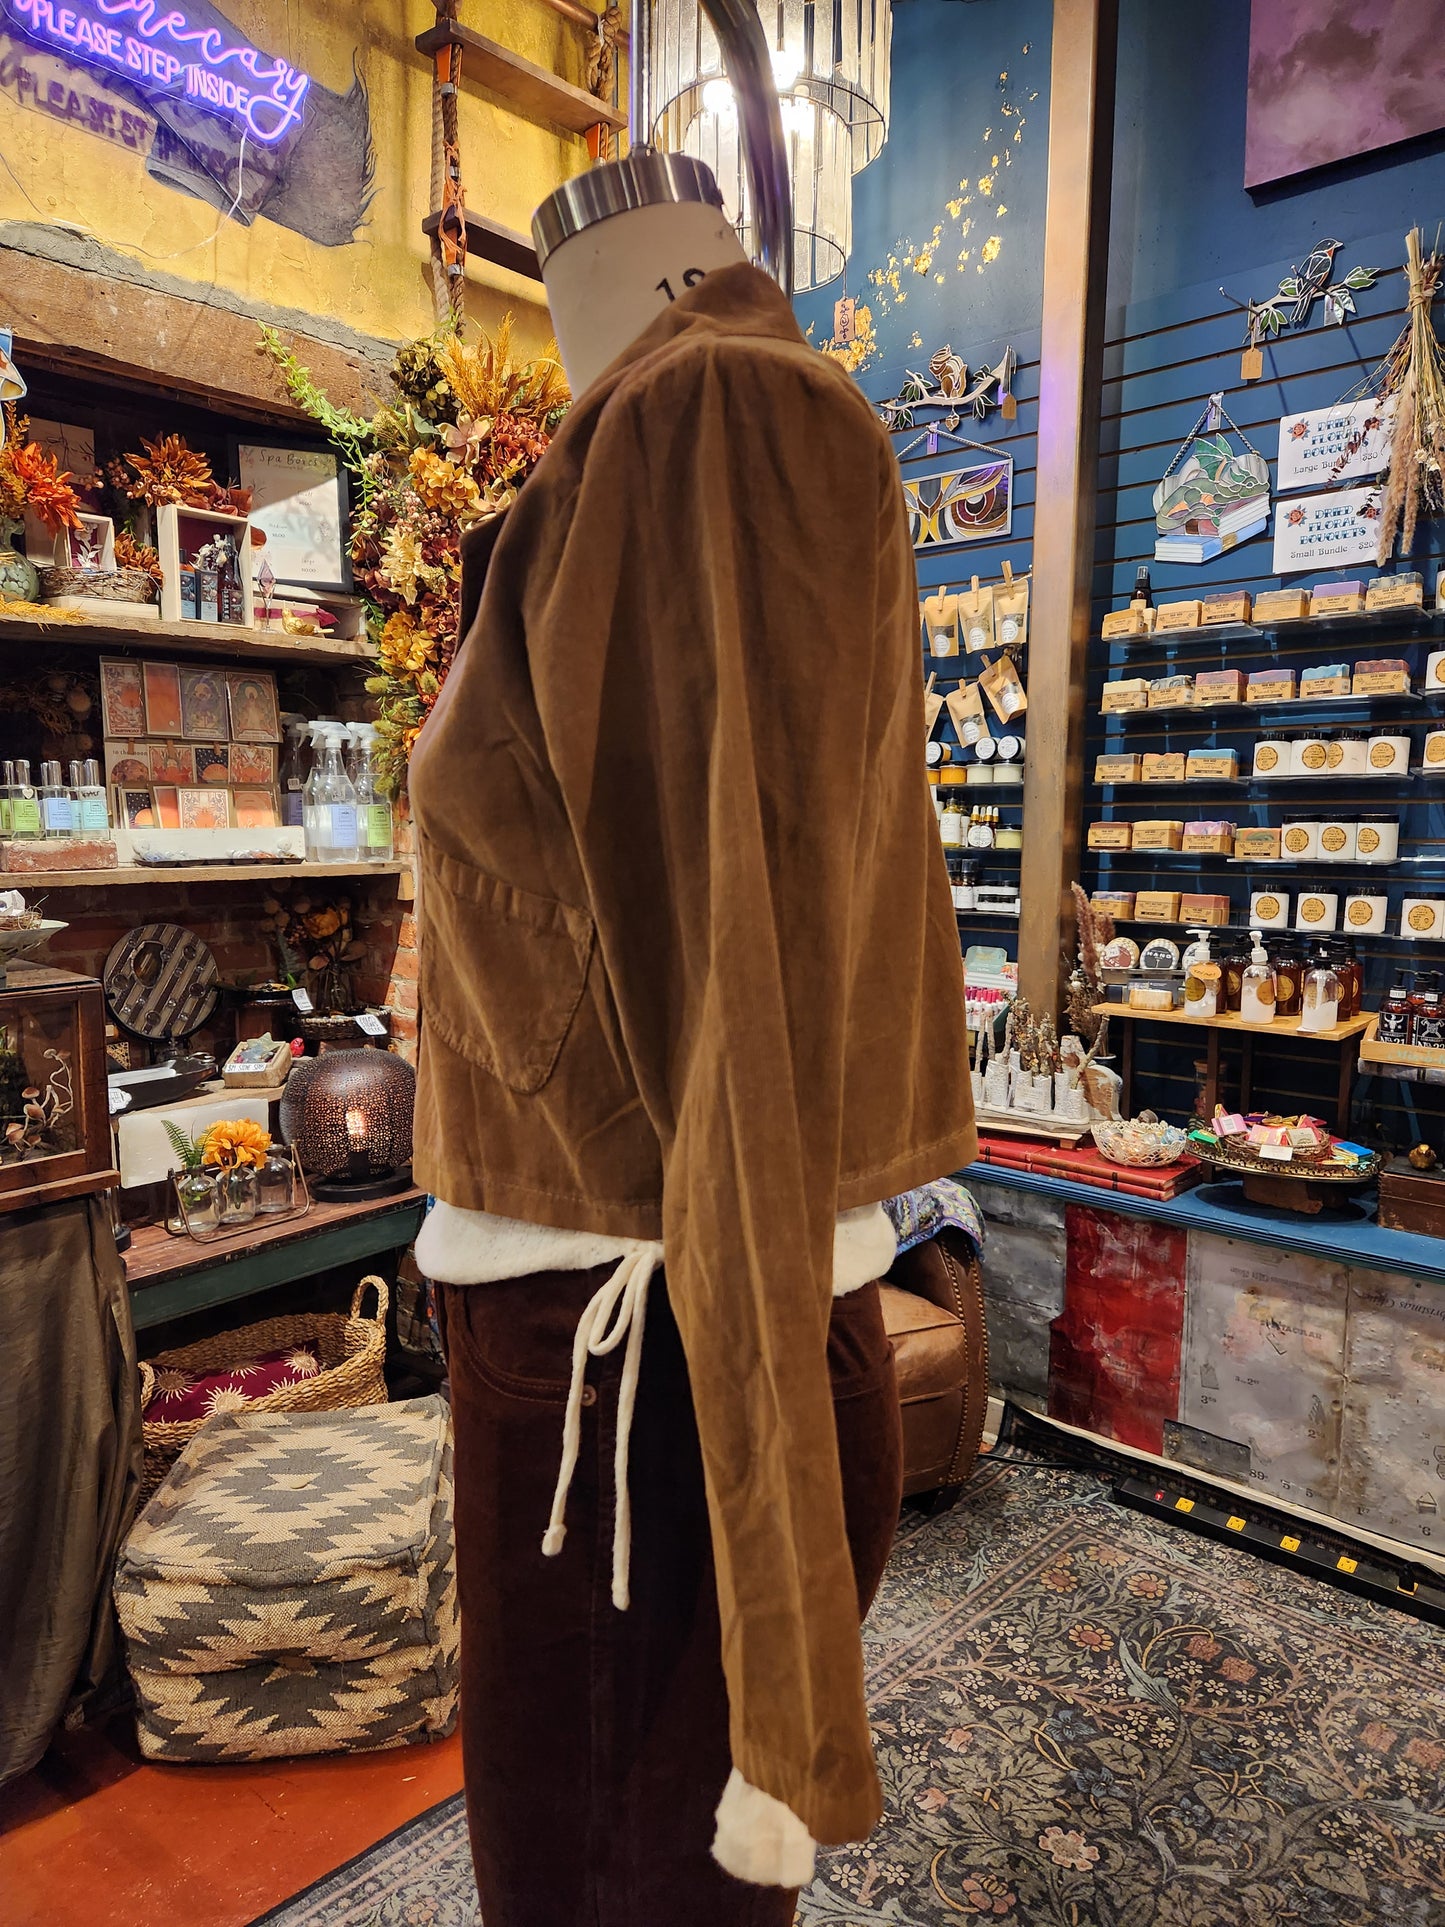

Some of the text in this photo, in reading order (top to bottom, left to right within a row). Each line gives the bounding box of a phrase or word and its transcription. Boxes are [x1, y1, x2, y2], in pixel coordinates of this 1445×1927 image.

[32, 0, 250, 114] PLEASE STEP INSIDE
[260, 449, 281, 465] Spa
[1294, 465, 1319, 474] Large
[1322, 458, 1351, 469] Bune
[1315, 505, 1354, 519] DRIED
[1308, 517, 1358, 532] FLORAL
[1300, 527, 1367, 545] BOUQUETS
[1290, 549, 1315, 559] Small
[1318, 546, 1348, 556] Bundle
[1358, 541, 1374, 550] $20
[1146, 951, 1172, 959] HAND
[1400, 1301, 1445, 1321] hristmas
